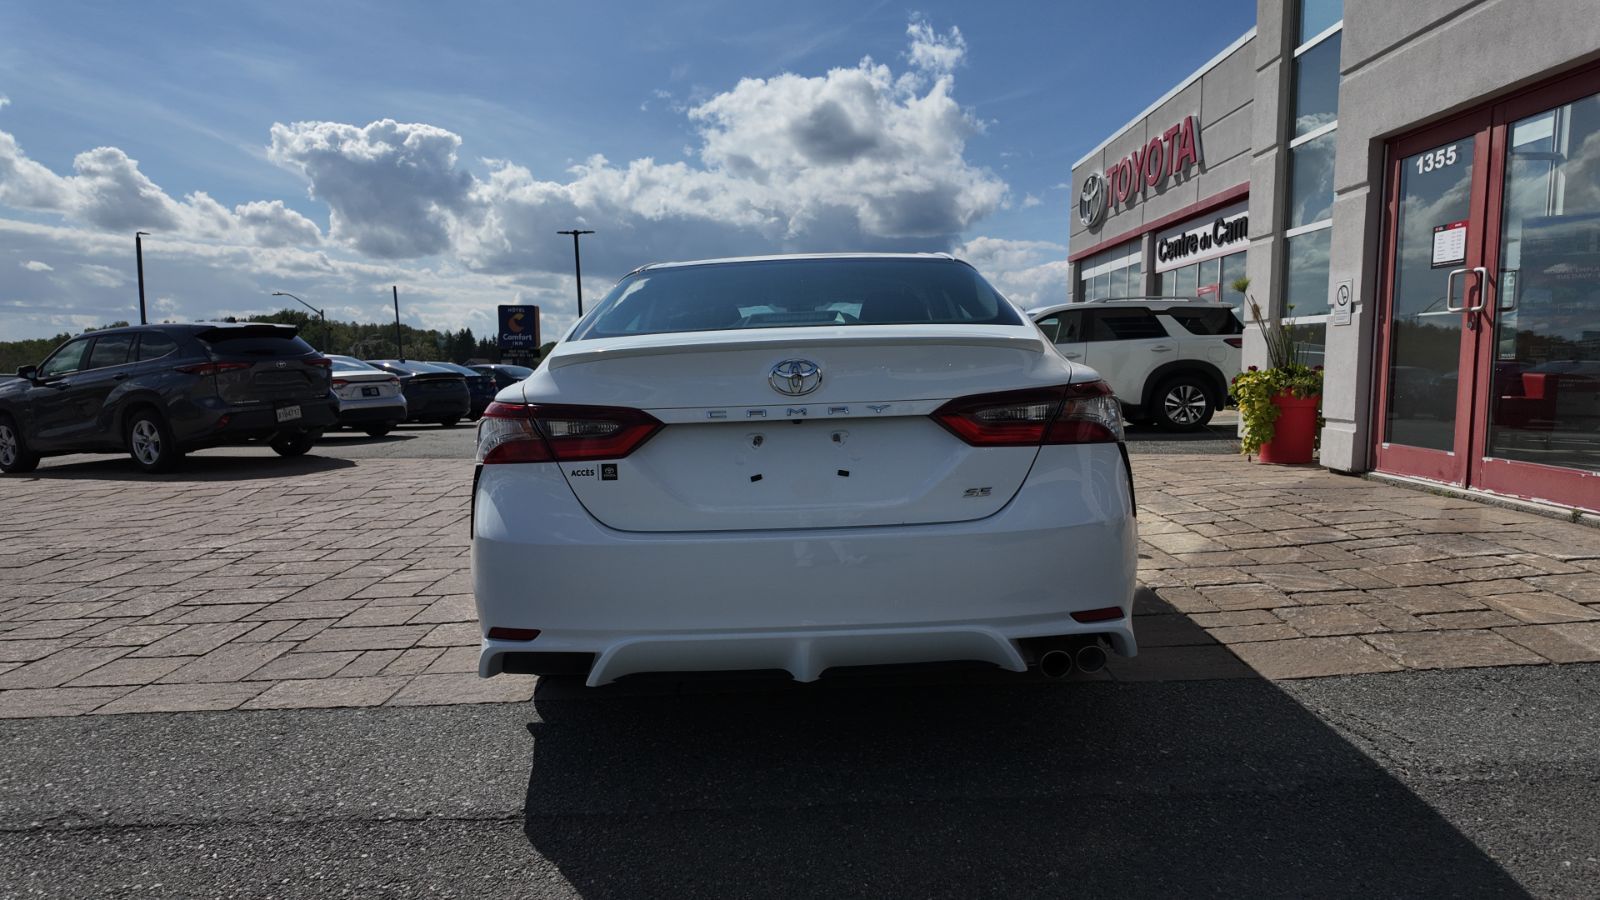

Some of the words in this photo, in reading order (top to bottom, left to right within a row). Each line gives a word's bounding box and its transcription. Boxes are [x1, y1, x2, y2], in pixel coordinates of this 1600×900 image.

[1106, 115, 1198, 207] TOYOTA
[1416, 145, 1457, 174] 1355
[1157, 232, 1198, 263] Centre
[1199, 231, 1212, 250] du
[502, 333, 532, 341] Comfort
[707, 404, 891, 419] CAMRY
[571, 467, 595, 477] ACCÈS
[962, 486, 993, 498] SE
